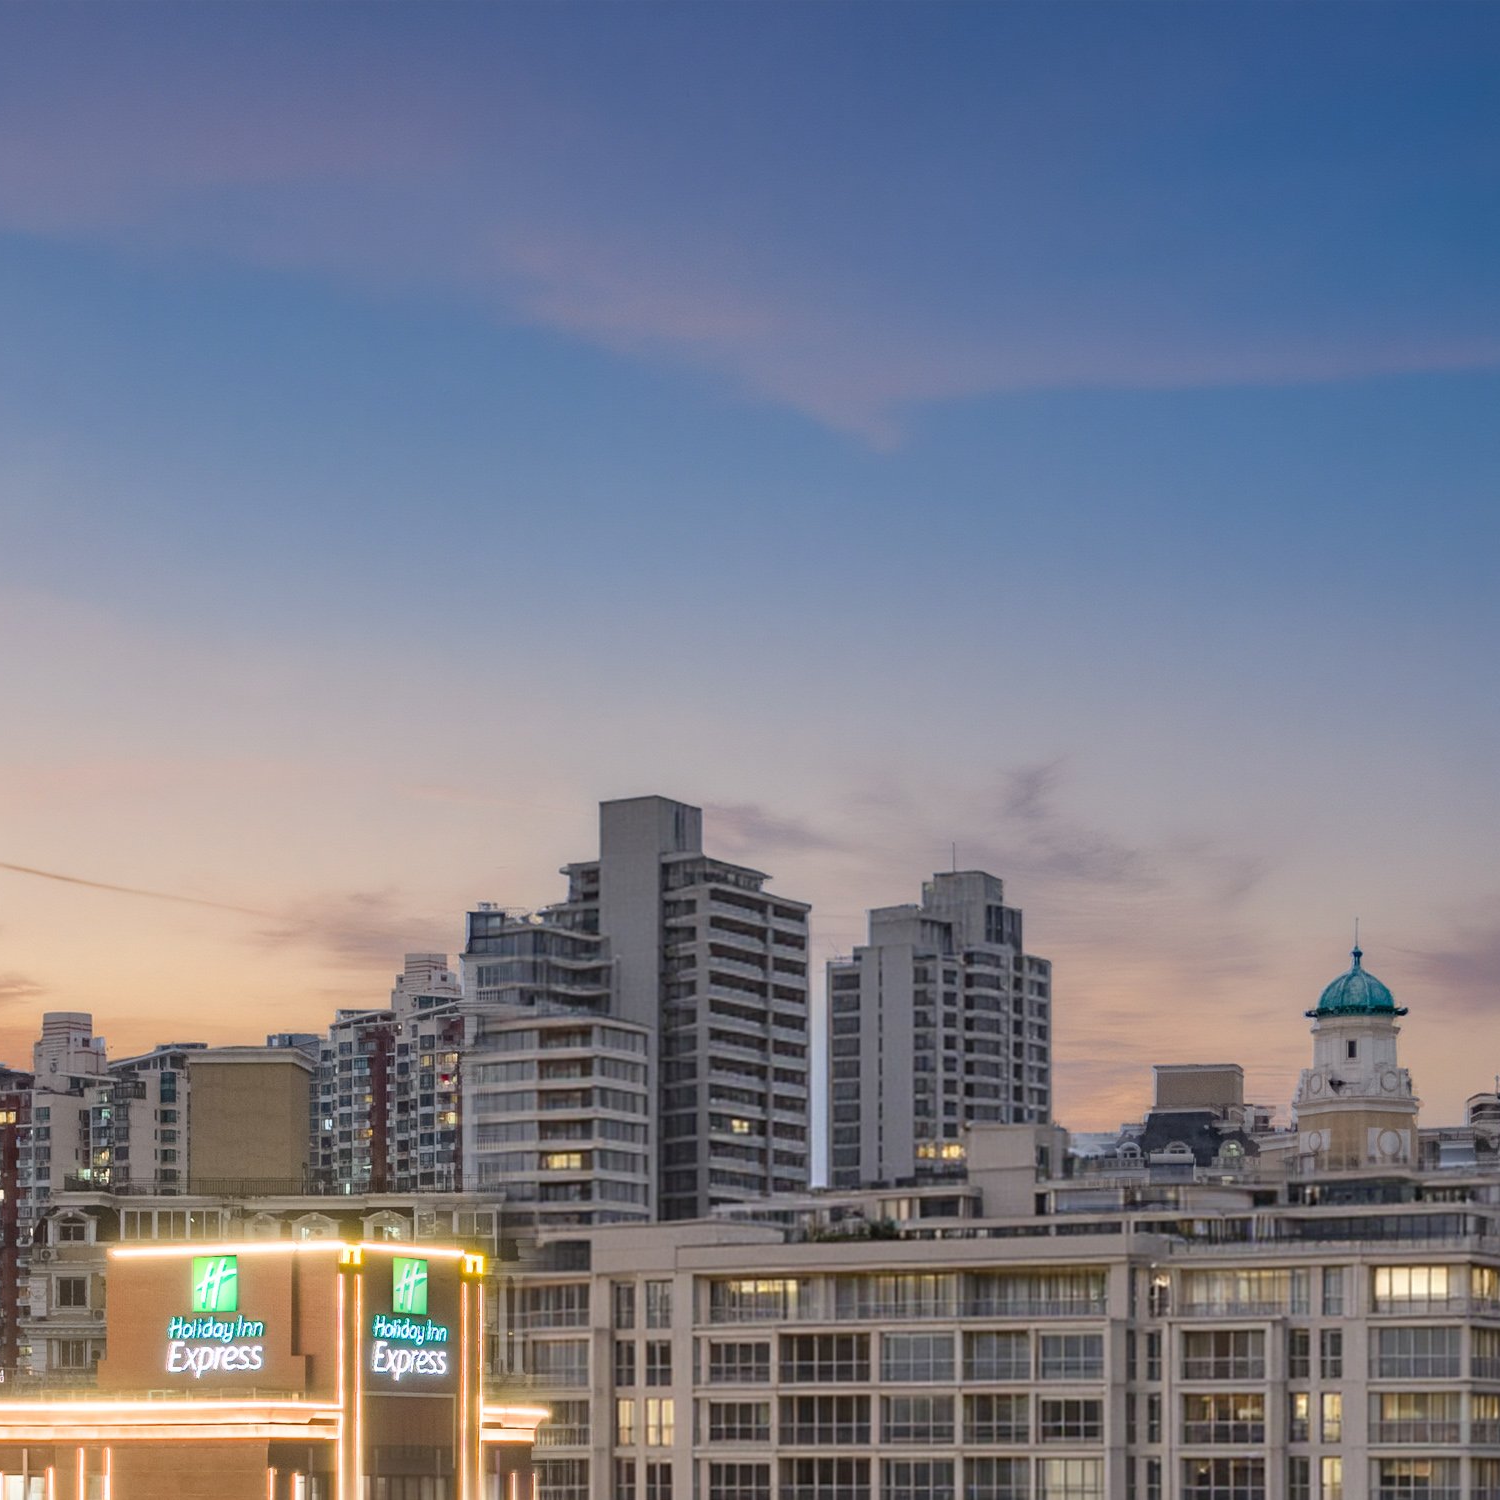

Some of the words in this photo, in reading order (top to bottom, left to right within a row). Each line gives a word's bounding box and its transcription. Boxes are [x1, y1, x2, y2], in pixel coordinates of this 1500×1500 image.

[167, 1315, 234, 1344] Holiday
[235, 1314, 265, 1338] Inn
[373, 1315, 425, 1346] Holiday
[426, 1319, 448, 1342] Inn
[166, 1341, 264, 1379] Express
[372, 1341, 448, 1381] Express
